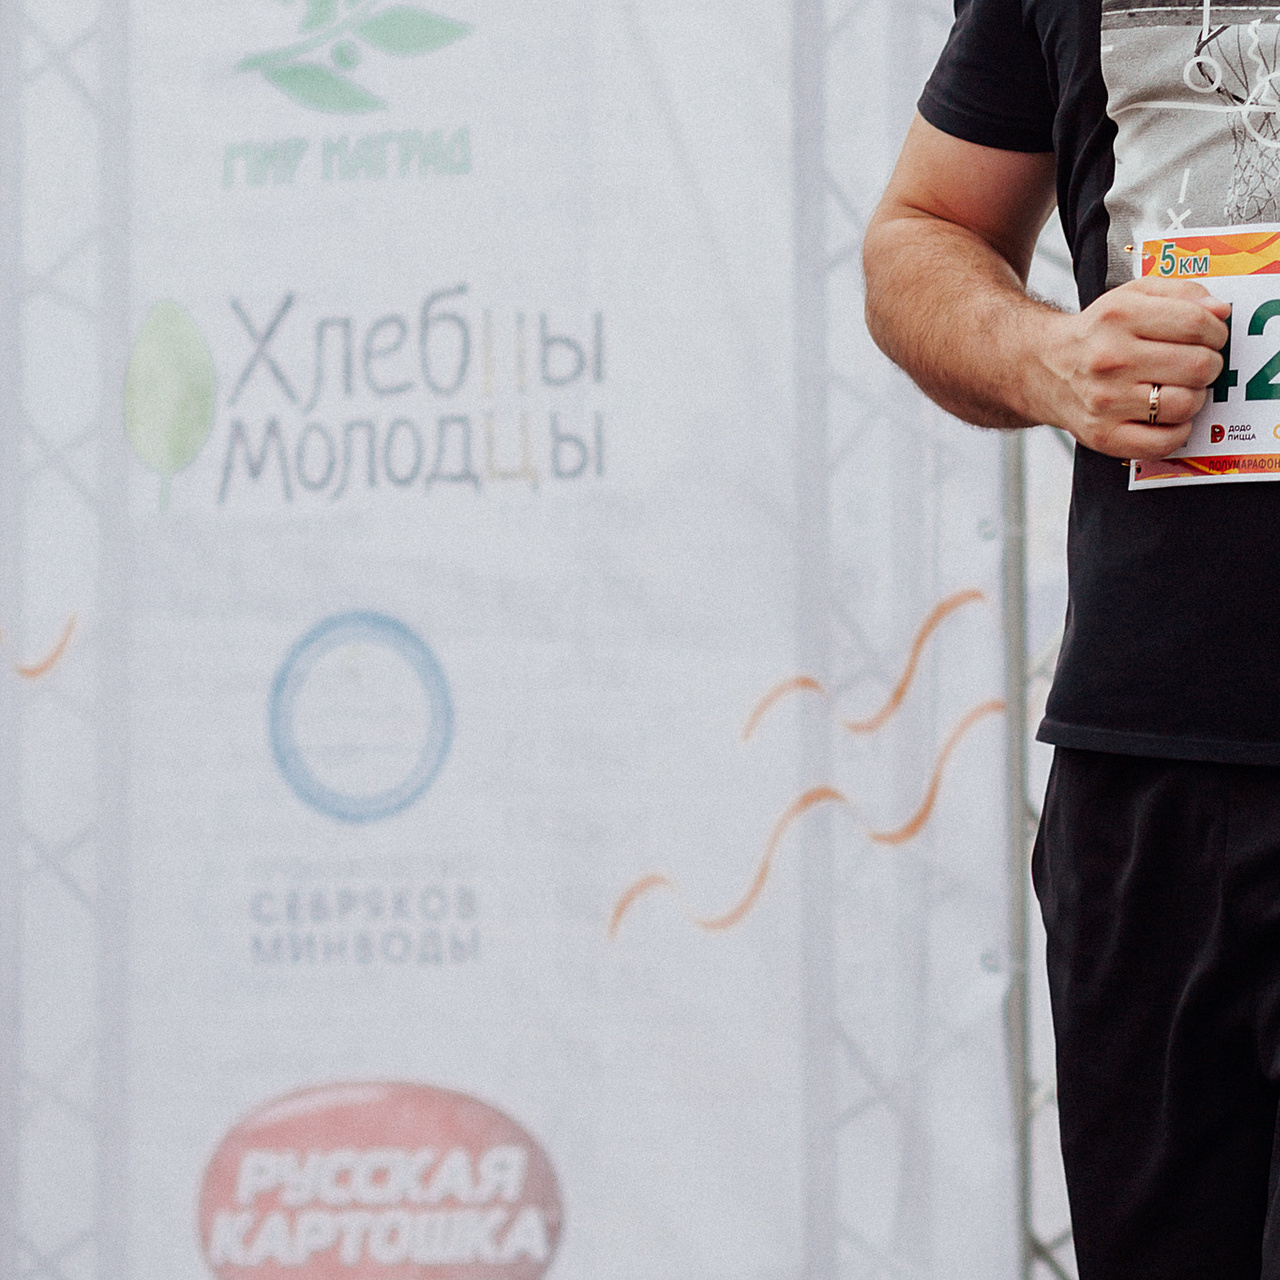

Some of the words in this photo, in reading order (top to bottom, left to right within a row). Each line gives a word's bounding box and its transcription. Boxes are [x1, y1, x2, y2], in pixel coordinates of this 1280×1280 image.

[1228, 424, 1251, 432] ДОДО
[1227, 433, 1256, 441] ПИЦЦА
[1208, 458, 1280, 471] ПОЛУМАРАФОН
[236, 1147, 528, 1206] РУССКАЯ
[208, 1207, 549, 1269] КАРТОШКА
